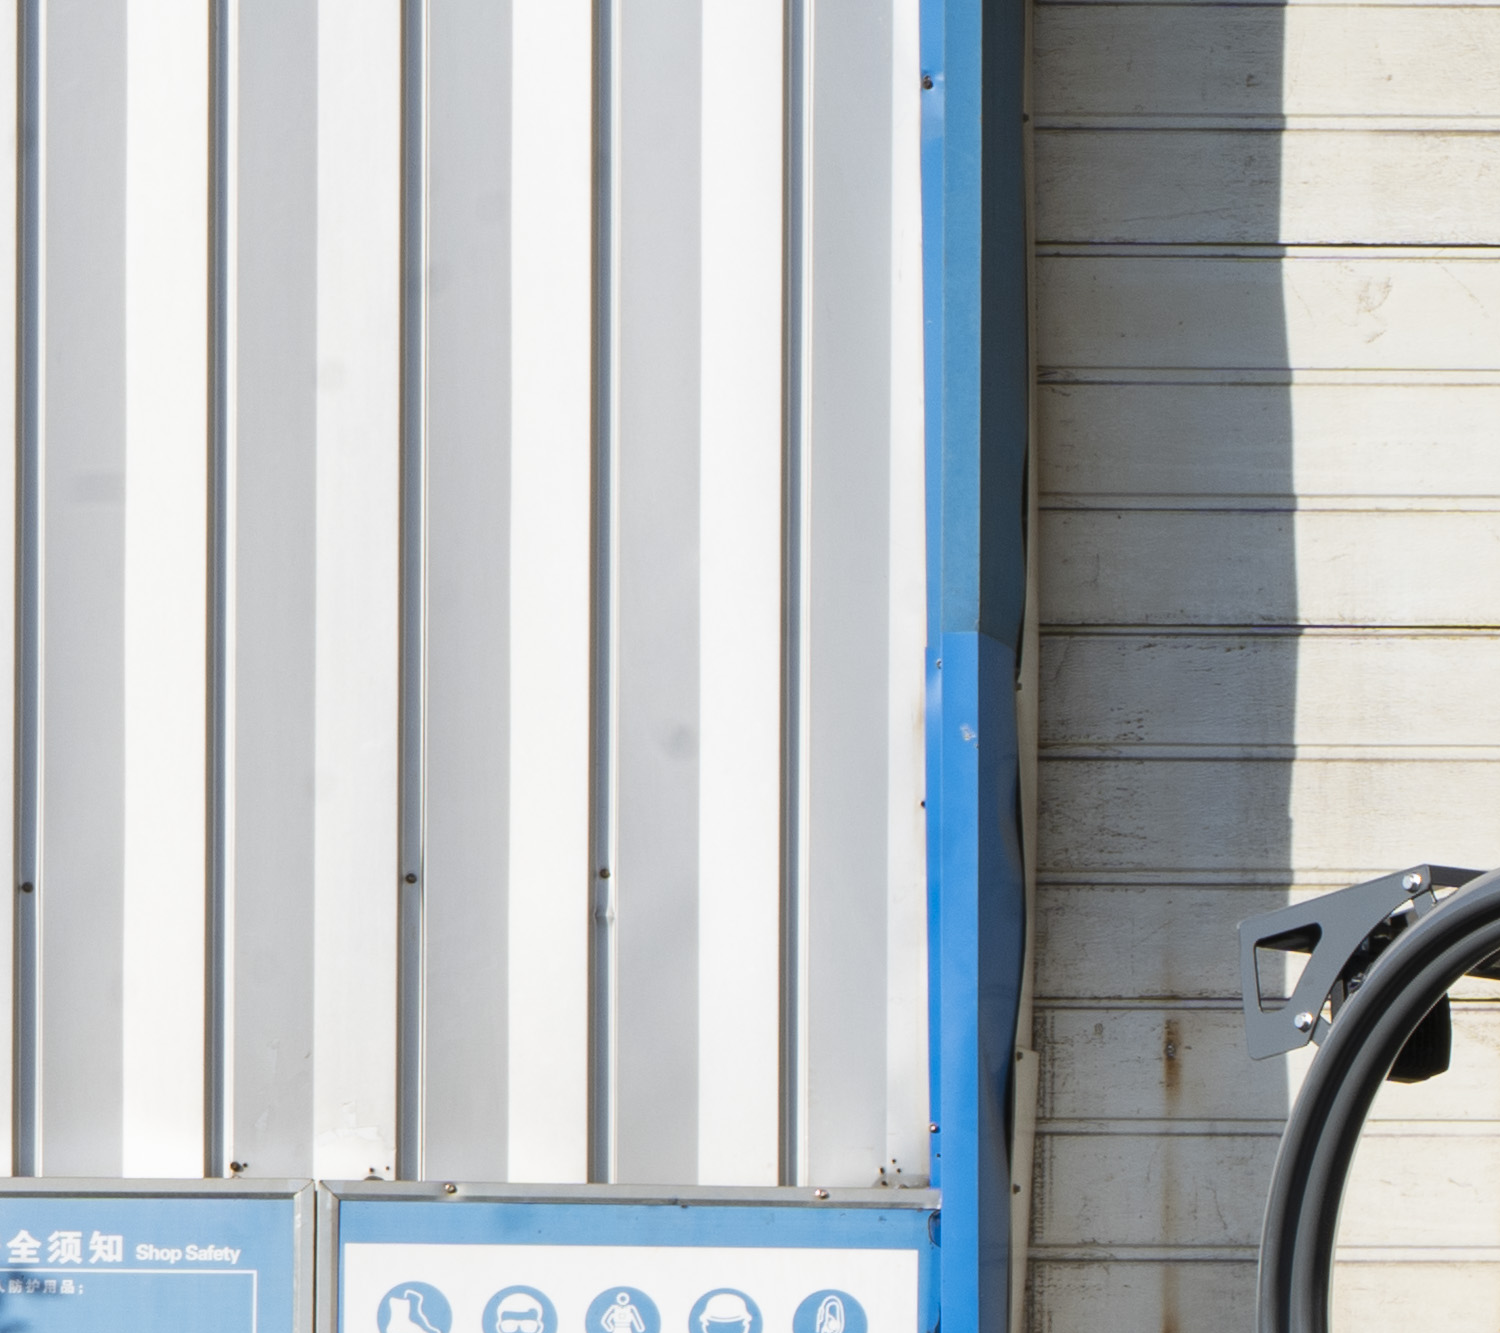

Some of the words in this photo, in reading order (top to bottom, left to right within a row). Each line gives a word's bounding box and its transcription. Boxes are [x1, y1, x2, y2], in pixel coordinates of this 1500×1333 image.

[7, 1229, 124, 1264] 全须知
[136, 1244, 183, 1263] Shop
[185, 1245, 241, 1264] Safety
